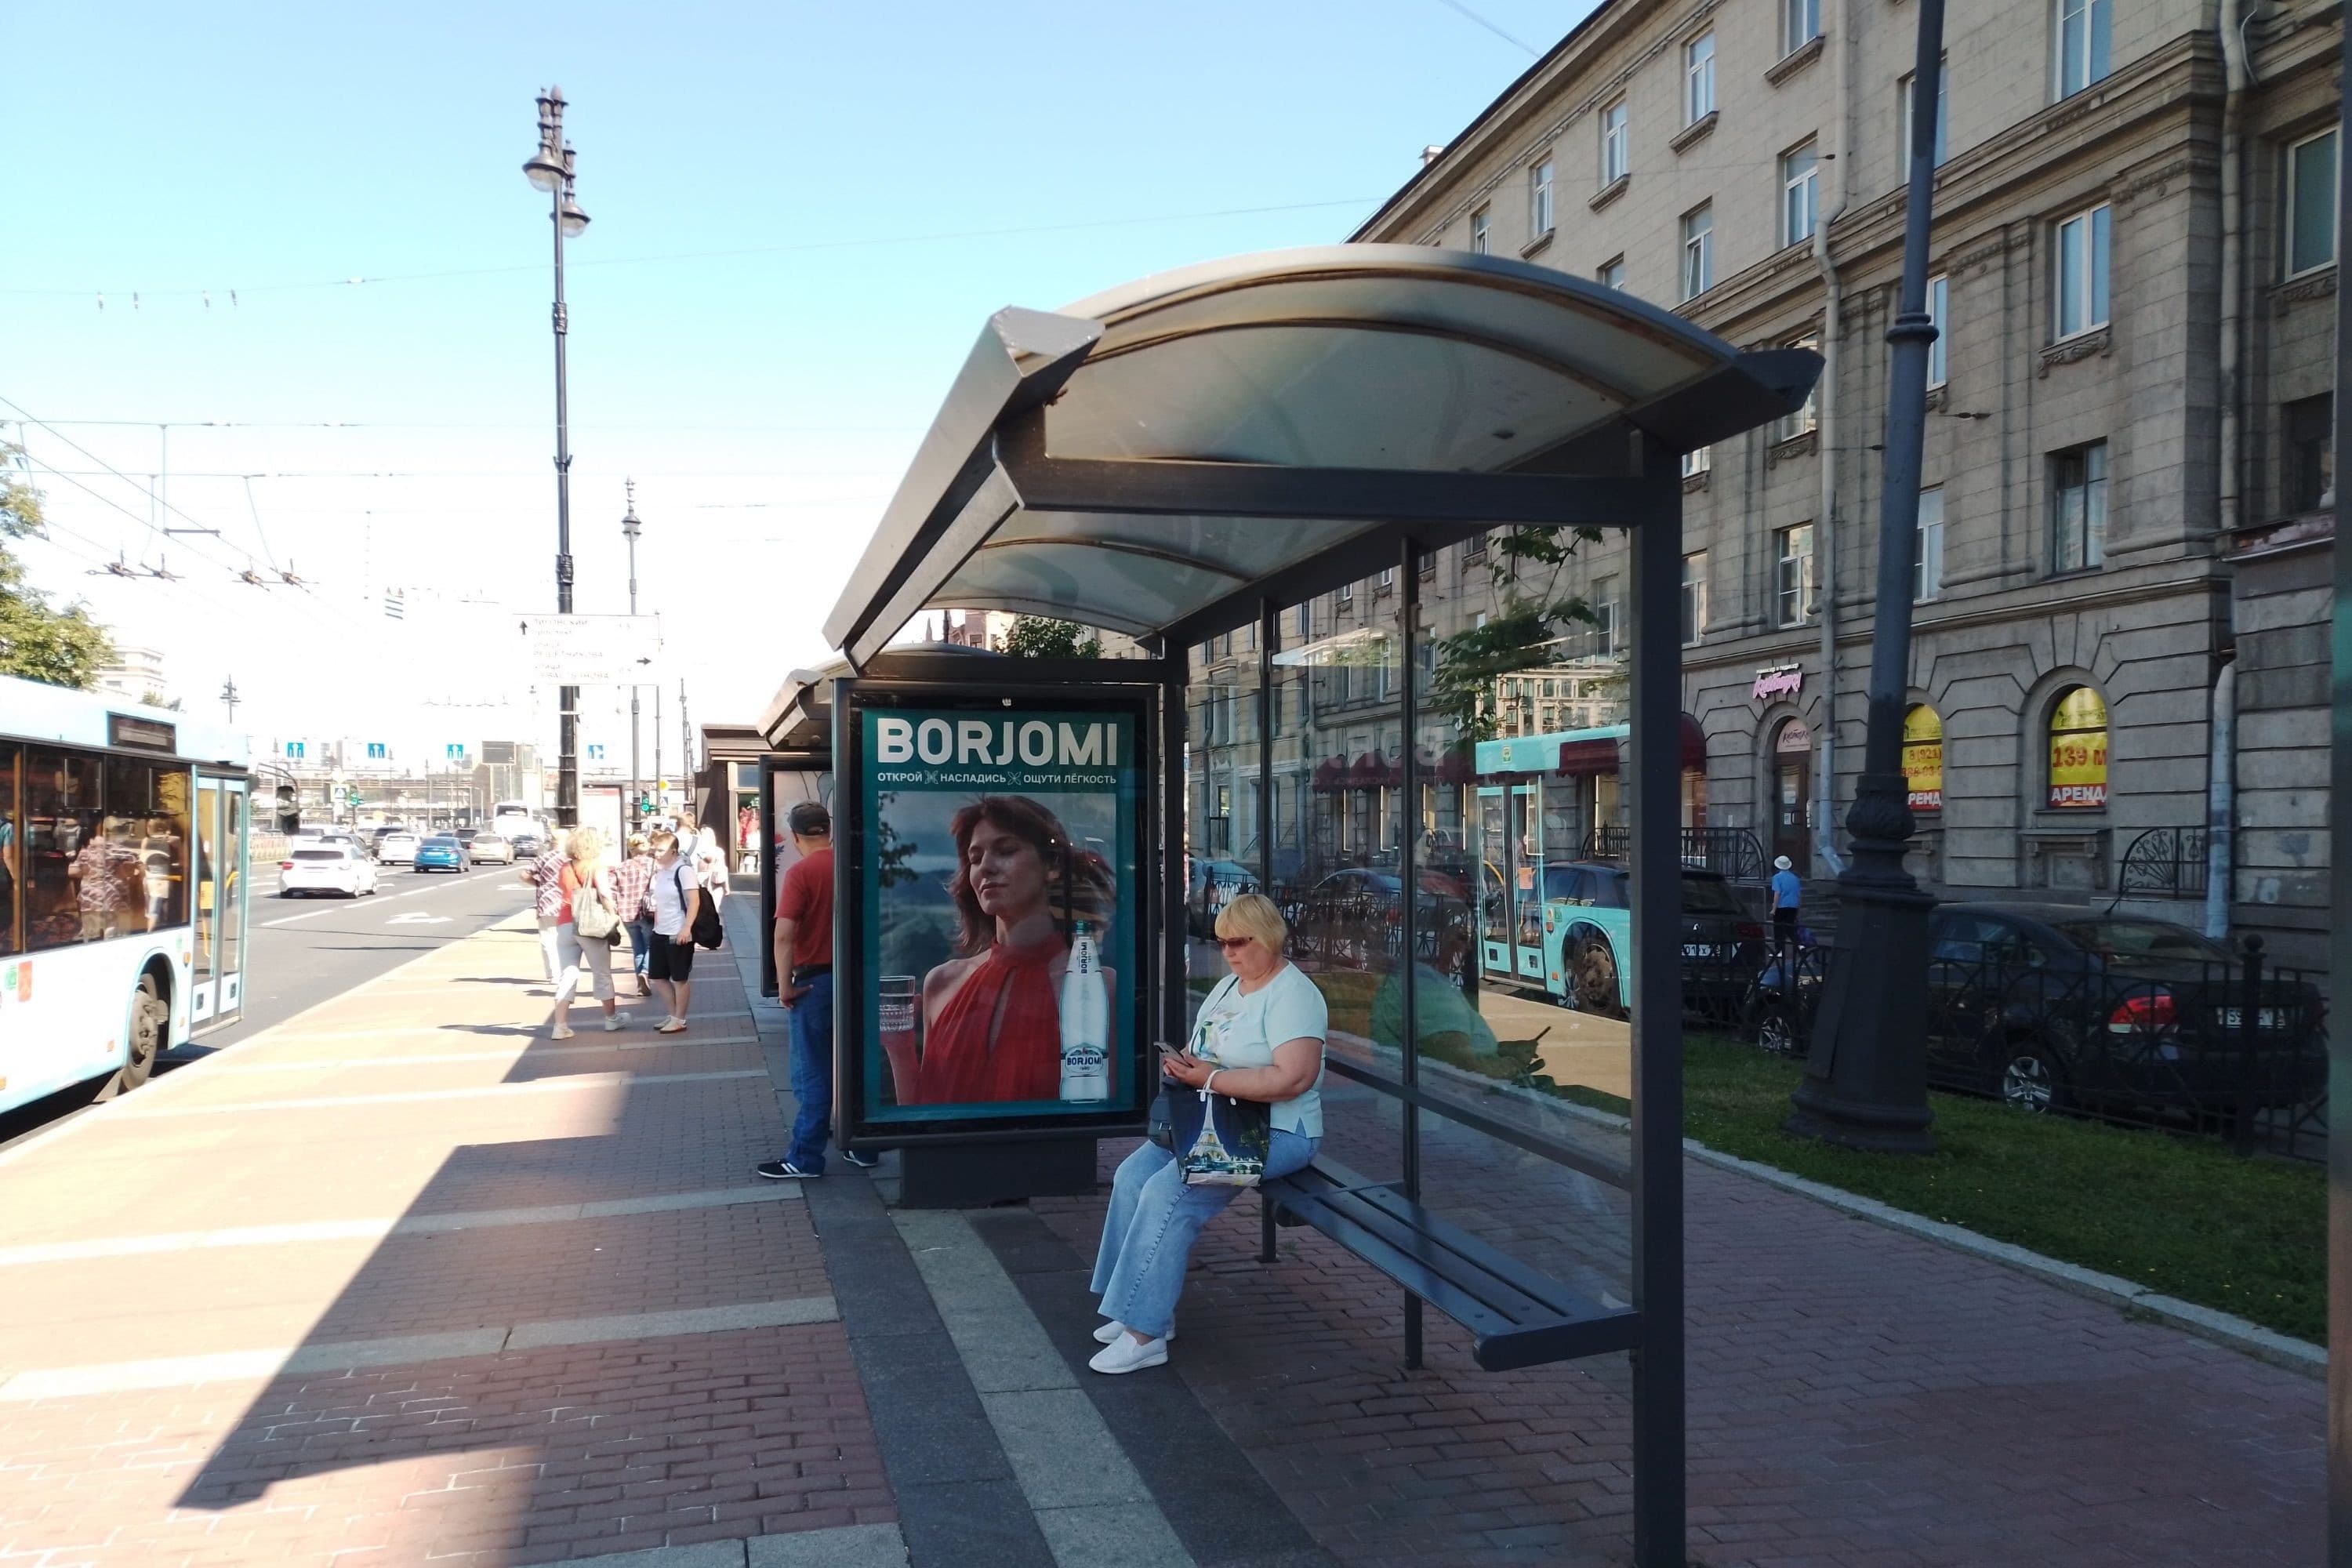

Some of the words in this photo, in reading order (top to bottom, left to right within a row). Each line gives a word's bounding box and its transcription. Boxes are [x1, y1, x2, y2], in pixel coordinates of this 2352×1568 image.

[877, 717, 1117, 766] BORJOMI
[2052, 746, 2088, 768] 139
[877, 771, 922, 782] ОТКРОЙ
[941, 773, 1006, 784] НАСЛАДИСЬ
[1024, 775, 1061, 785] ОЩУТИ
[1064, 773, 1116, 784] ЛЁГКОСТЬ
[1908, 792, 1941, 807] РЕНД
[2051, 786, 2107, 803] АРЕНД
[1067, 1057, 1102, 1065] BORJOMI
